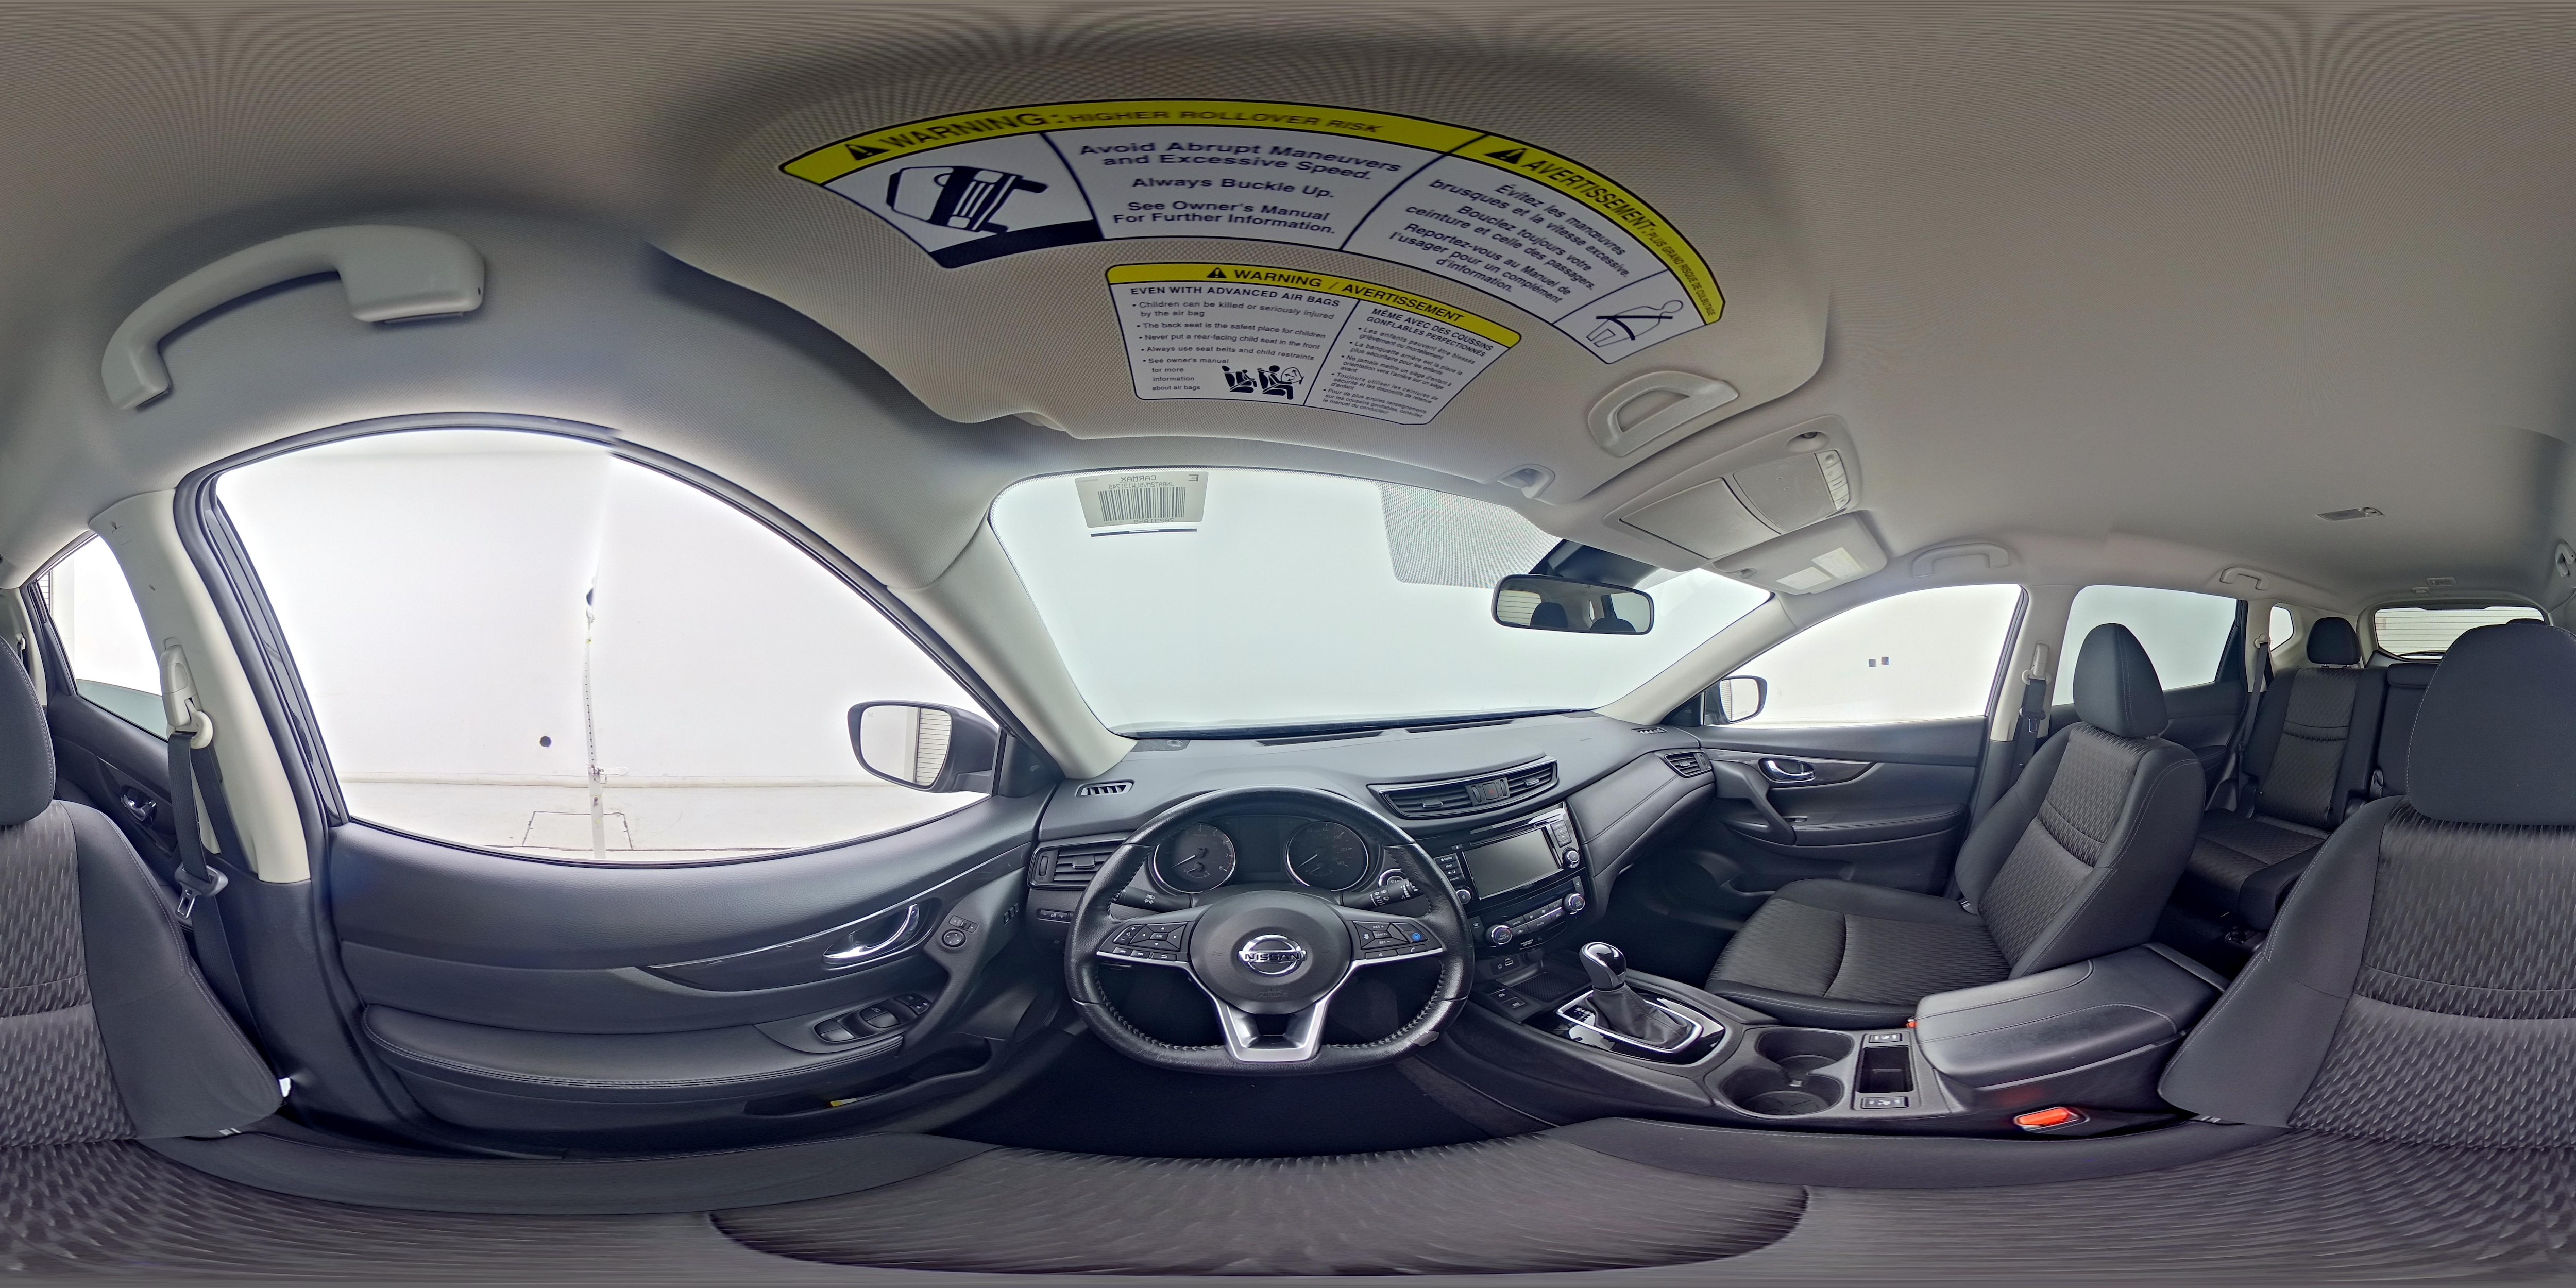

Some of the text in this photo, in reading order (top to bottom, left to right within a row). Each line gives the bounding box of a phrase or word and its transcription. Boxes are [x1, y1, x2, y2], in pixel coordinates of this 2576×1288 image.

[1069, 111, 1169, 123] HIGHER
[1180, 111, 1321, 125] ROLLOVER
[1326, 119, 1384, 133] RISK
[1080, 142, 1402, 172] Avoid Abrupt Maneuvers
[1103, 154, 1371, 180] and Excessive Speed.
[1132, 178, 1334, 198] Always Buckle Up.
[1495, 184, 1545, 208] Évitez
[1543, 205, 1567, 218] les
[1113, 213, 1335, 234] For Further Information.
[1128, 201, 1331, 221] See Owner's Manual
[1428, 179, 1630, 278] brusques et la vitesse excessive.
[1456, 205, 1592, 272] Bouclez toujours votre
[1520, 160, 1716, 316] AVERTISSEMENT: PLUS GRAND RISQUE DE CULBUTAGE
[1404, 223, 1571, 295] Reportez-vous au Manuel de
[1405, 206, 1595, 290] ceinture et celle des passagers.
[1389, 232, 1564, 303] l'usager pour un complément
[1435, 258, 1513, 292] d'information.
[1130, 286, 1165, 295] EVEN
[1207, 286, 1278, 298] ADVANCED
[1281, 293, 1303, 301] AIR
[1306, 296, 1340, 307] BAGS
[1234, 269, 1464, 322] WARNING / AVERTISSEMENT
[1259, 305, 1301, 315] seriously
[1303, 310, 1335, 320] injured
[1294, 330, 1326, 339] children
[1366, 316, 1486, 357] GONFLABLES PERFECTIONNÉS
[1371, 308, 1493, 351] MÊME AVEC DES COUSSINS
[1278, 351, 1315, 361] restraints
[1365, 344, 1400, 357] banquette
[1400, 352, 1422, 362] arrière
[1439, 364, 1456, 373] place
[1379, 331, 1408, 343] enfants
[1408, 340, 1437, 351] peuvent
[1437, 348, 1451, 356] être
[1451, 352, 1476, 365] blessés
